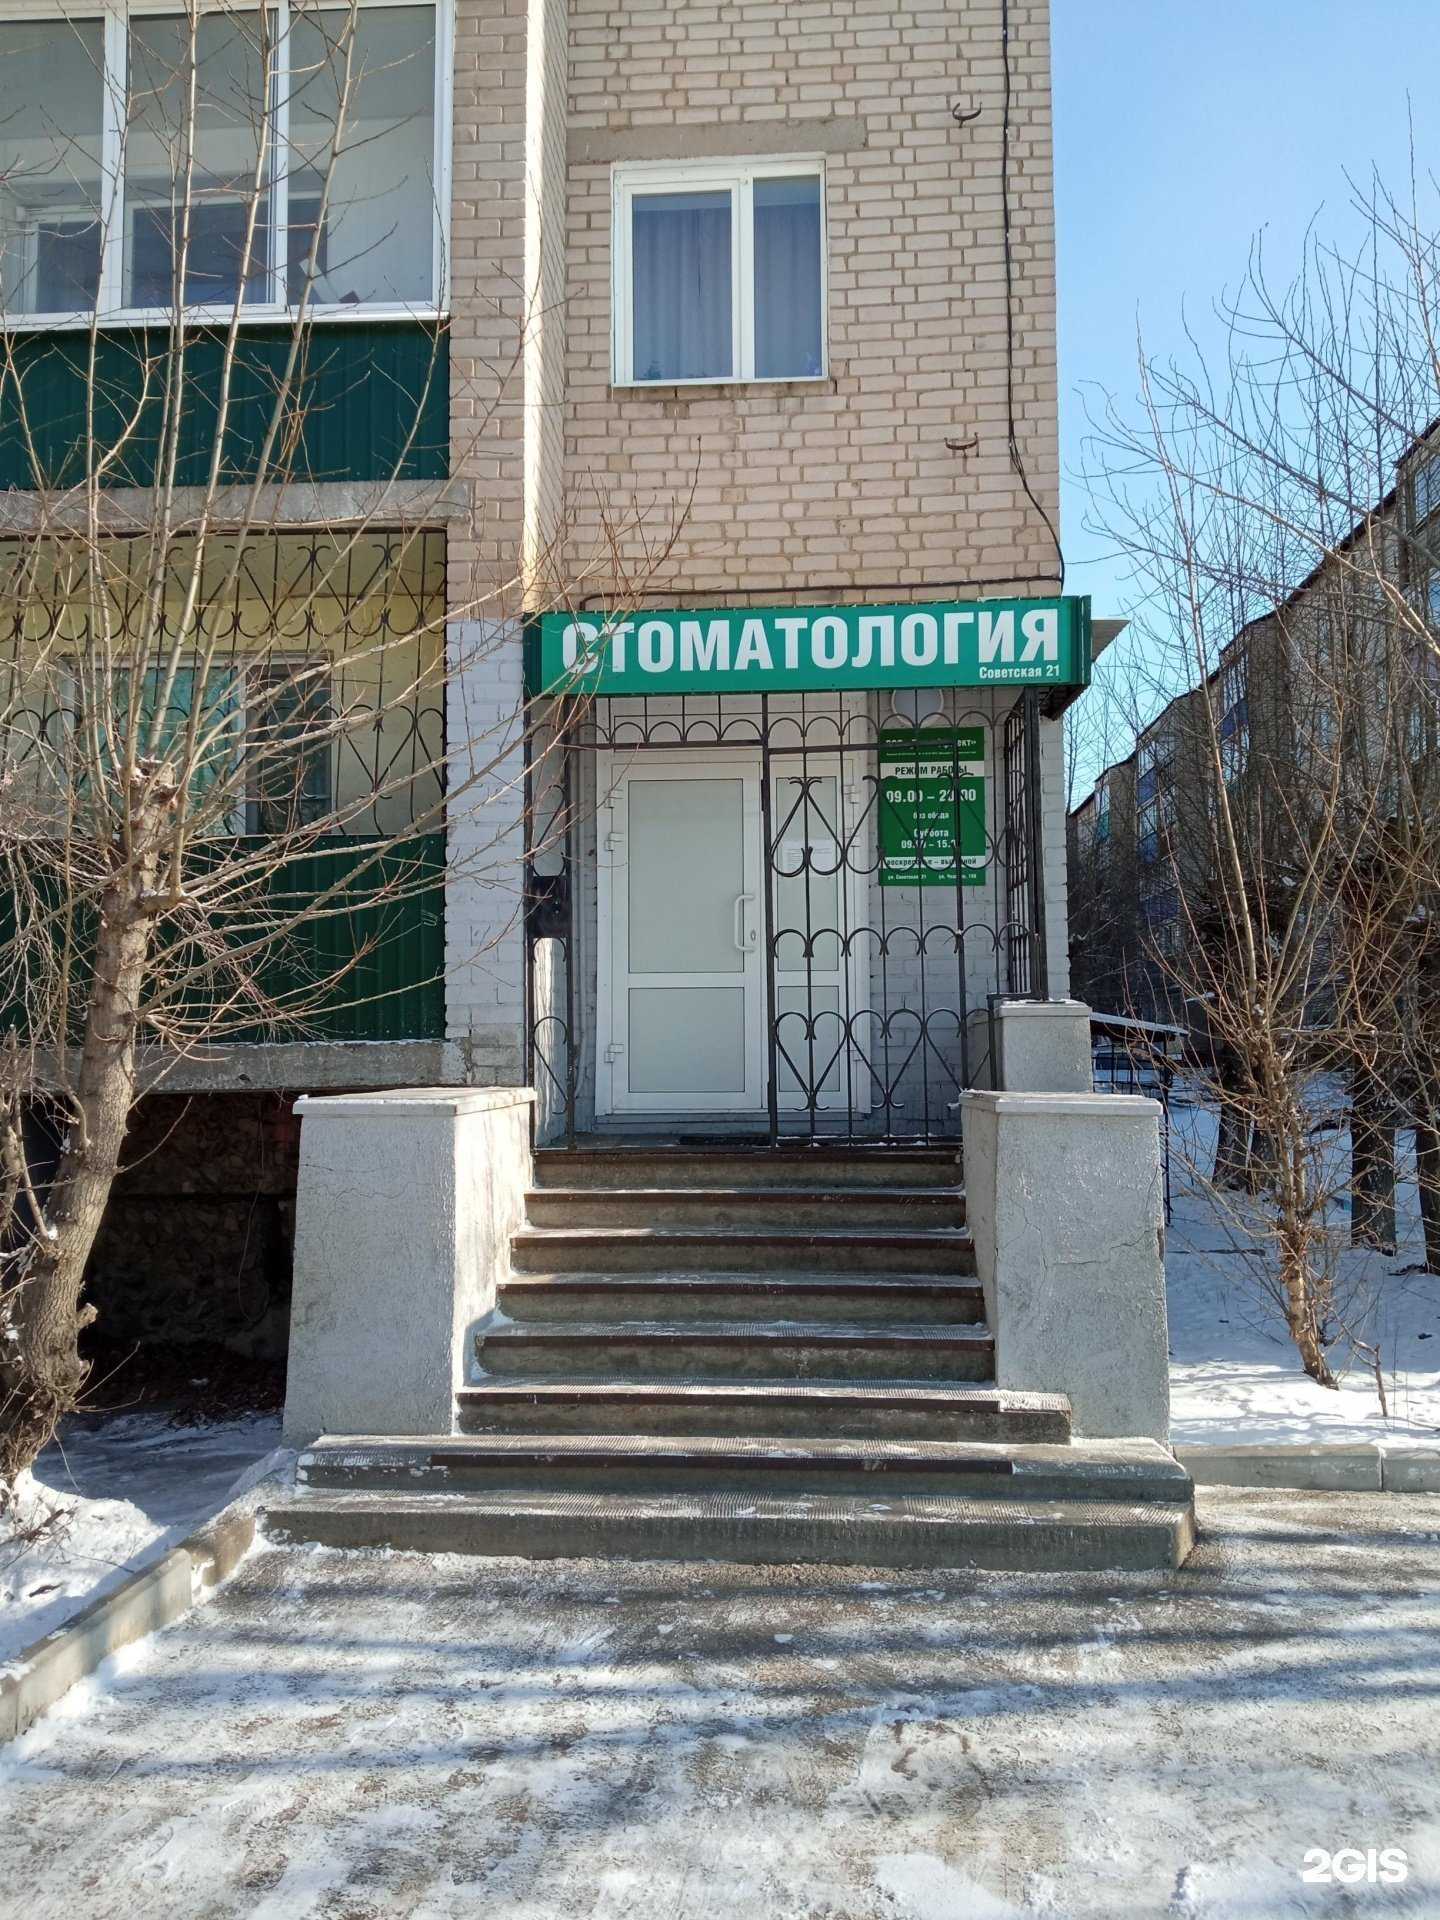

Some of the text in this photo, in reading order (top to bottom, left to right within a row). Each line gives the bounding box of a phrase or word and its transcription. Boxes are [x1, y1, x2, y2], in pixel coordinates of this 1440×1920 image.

[562, 609, 1058, 674] СТОМАТОЛОГИЯ
[979, 664, 1060, 679] Советская 21
[895, 764, 967, 776] РЕЖМ РАБОЫ
[939, 788, 976, 802] 2000
[901, 840, 927, 849] 09.
